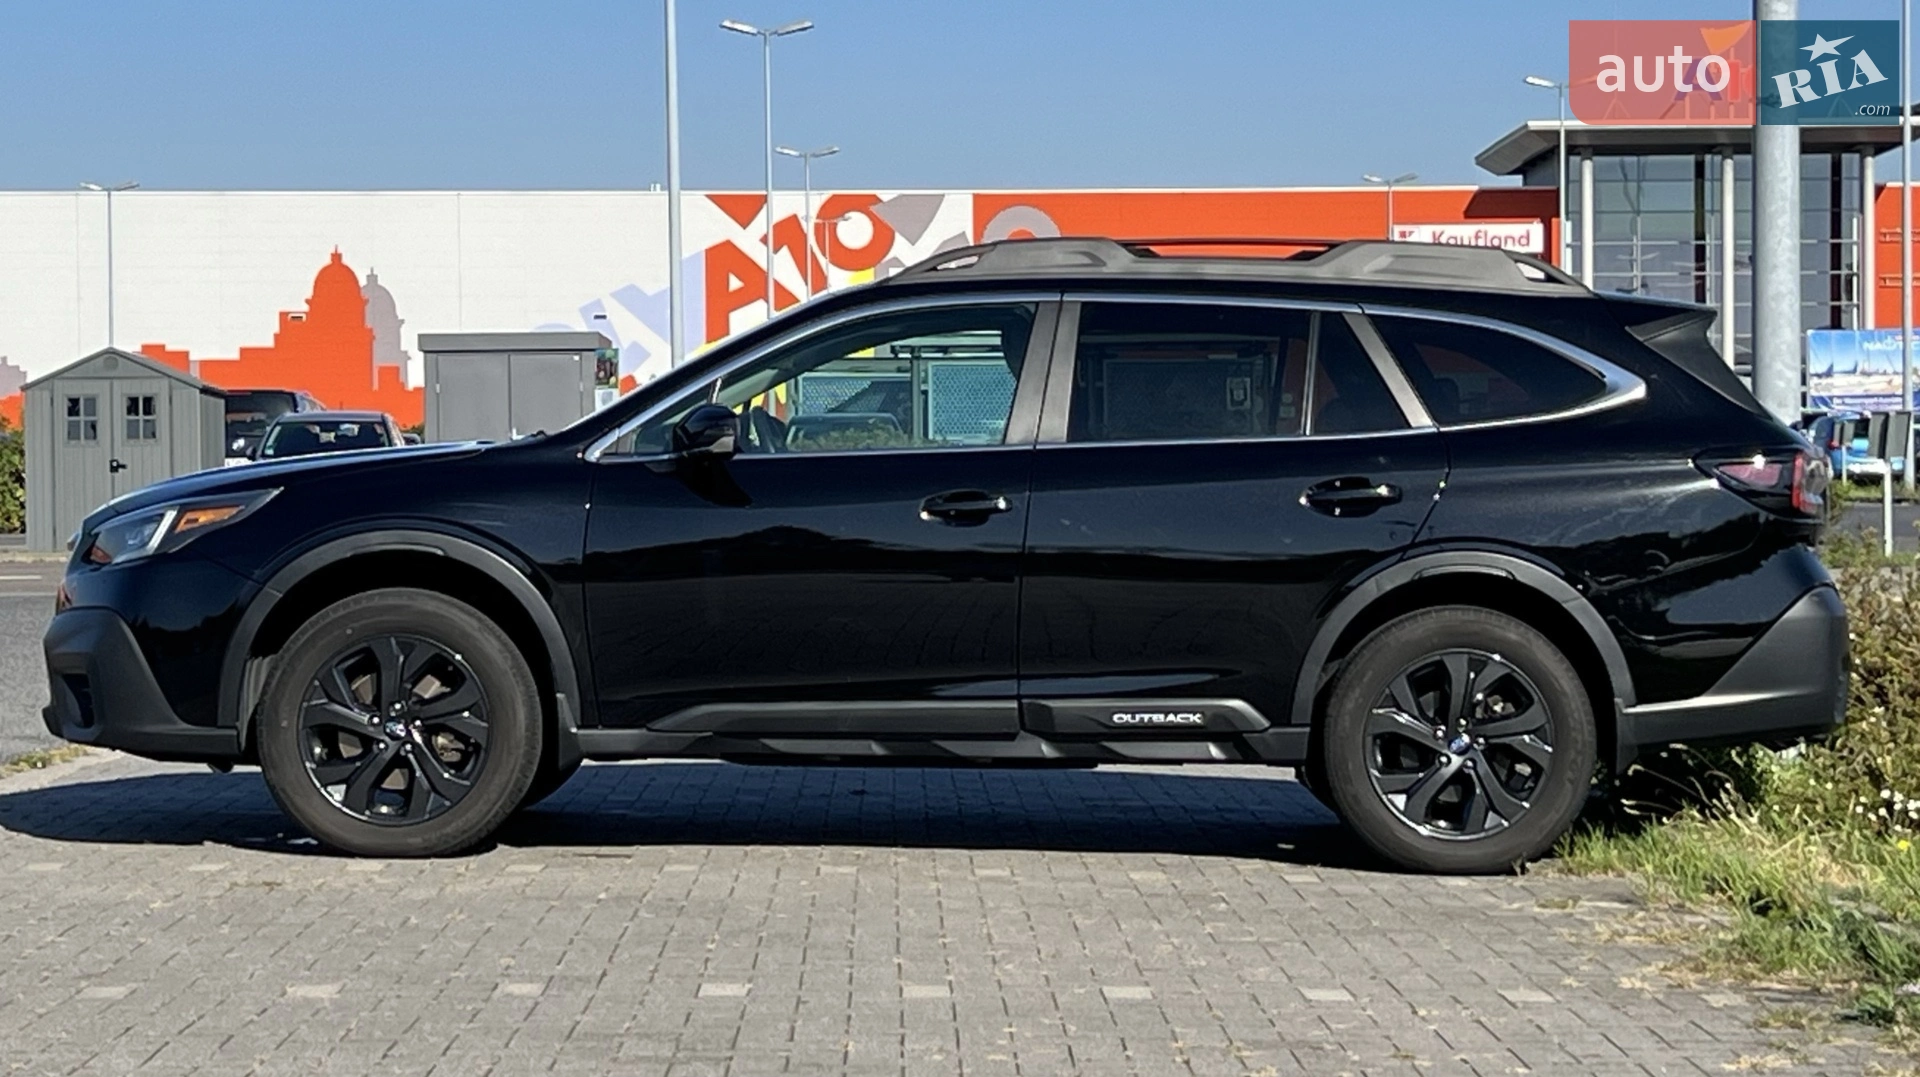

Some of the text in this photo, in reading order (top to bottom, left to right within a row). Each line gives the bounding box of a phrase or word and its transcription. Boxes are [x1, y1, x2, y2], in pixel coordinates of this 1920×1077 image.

[1432, 229, 1530, 248] Kaufland
[705, 193, 896, 345] A10
[1112, 713, 1202, 723] OUTBACK
